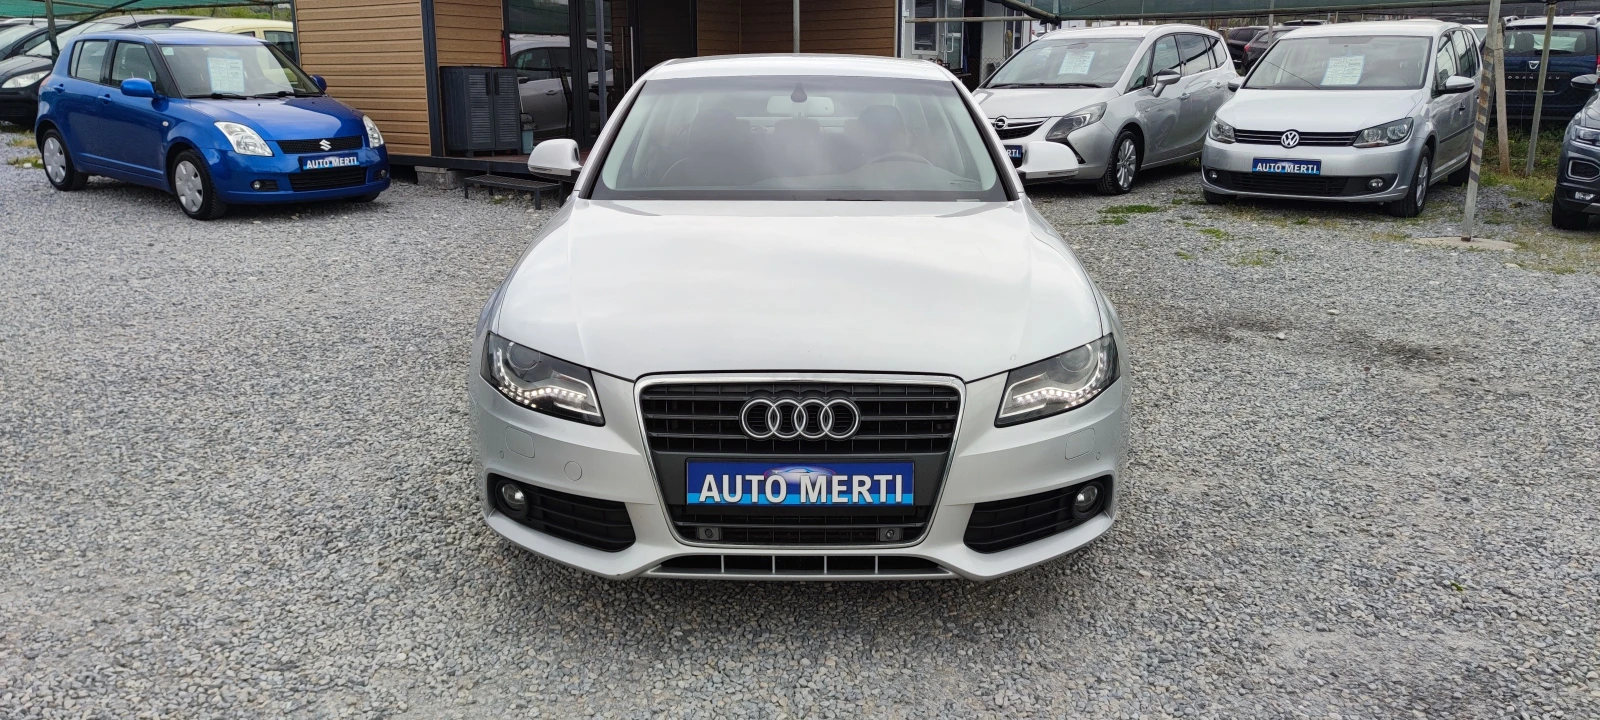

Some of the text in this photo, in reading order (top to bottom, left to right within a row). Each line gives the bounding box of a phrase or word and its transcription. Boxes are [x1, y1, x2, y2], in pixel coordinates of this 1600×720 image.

[1007, 149, 1019, 157] RTI
[306, 156, 357, 169] AUTO MERTI
[1256, 162, 1317, 174] AUTO MERTI
[699, 474, 902, 503] AUTO MERTI
